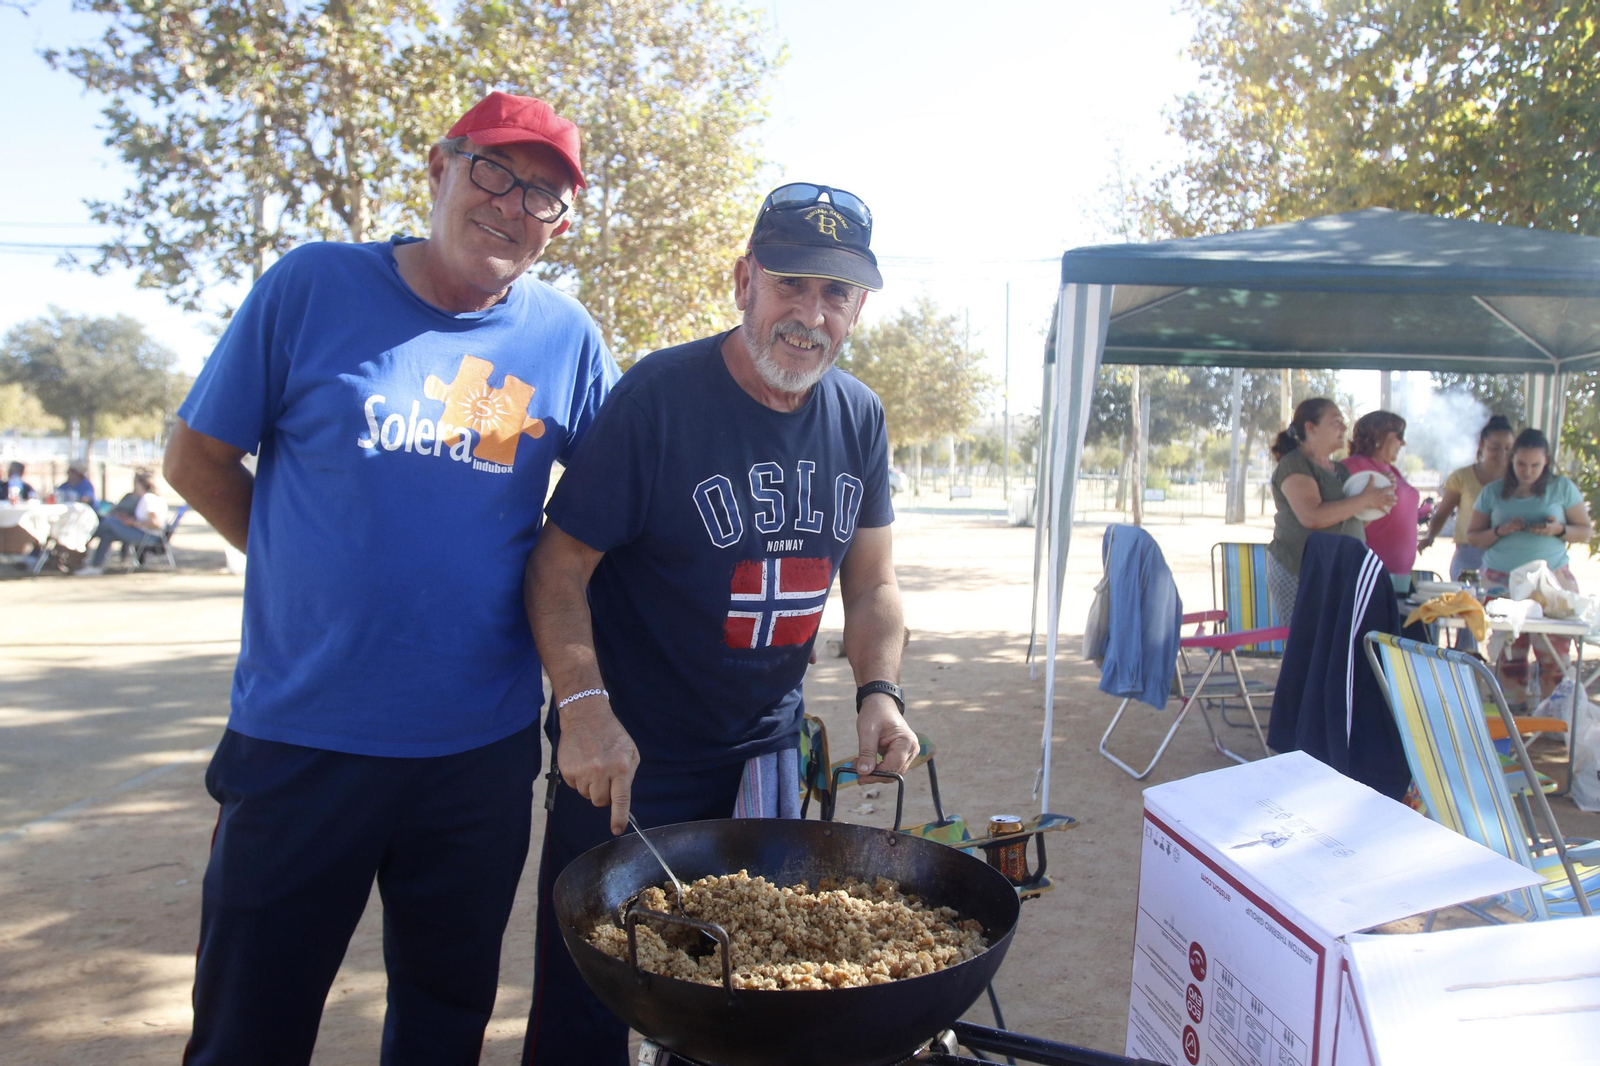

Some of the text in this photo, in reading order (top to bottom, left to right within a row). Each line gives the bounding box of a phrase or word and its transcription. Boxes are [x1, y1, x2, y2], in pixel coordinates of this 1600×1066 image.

[357, 394, 473, 464] Solera
[472, 458, 514, 474] indubox
[692, 460, 864, 549] OSLO
[766, 539, 804, 552] NORWAY
[1200, 872, 1231, 902] ariston.com
[1245, 907, 1313, 966] ARISTON THERMO GROUP
[1188, 986, 1203, 1006] EVO
[1187, 1001, 1201, 1020] ECO
